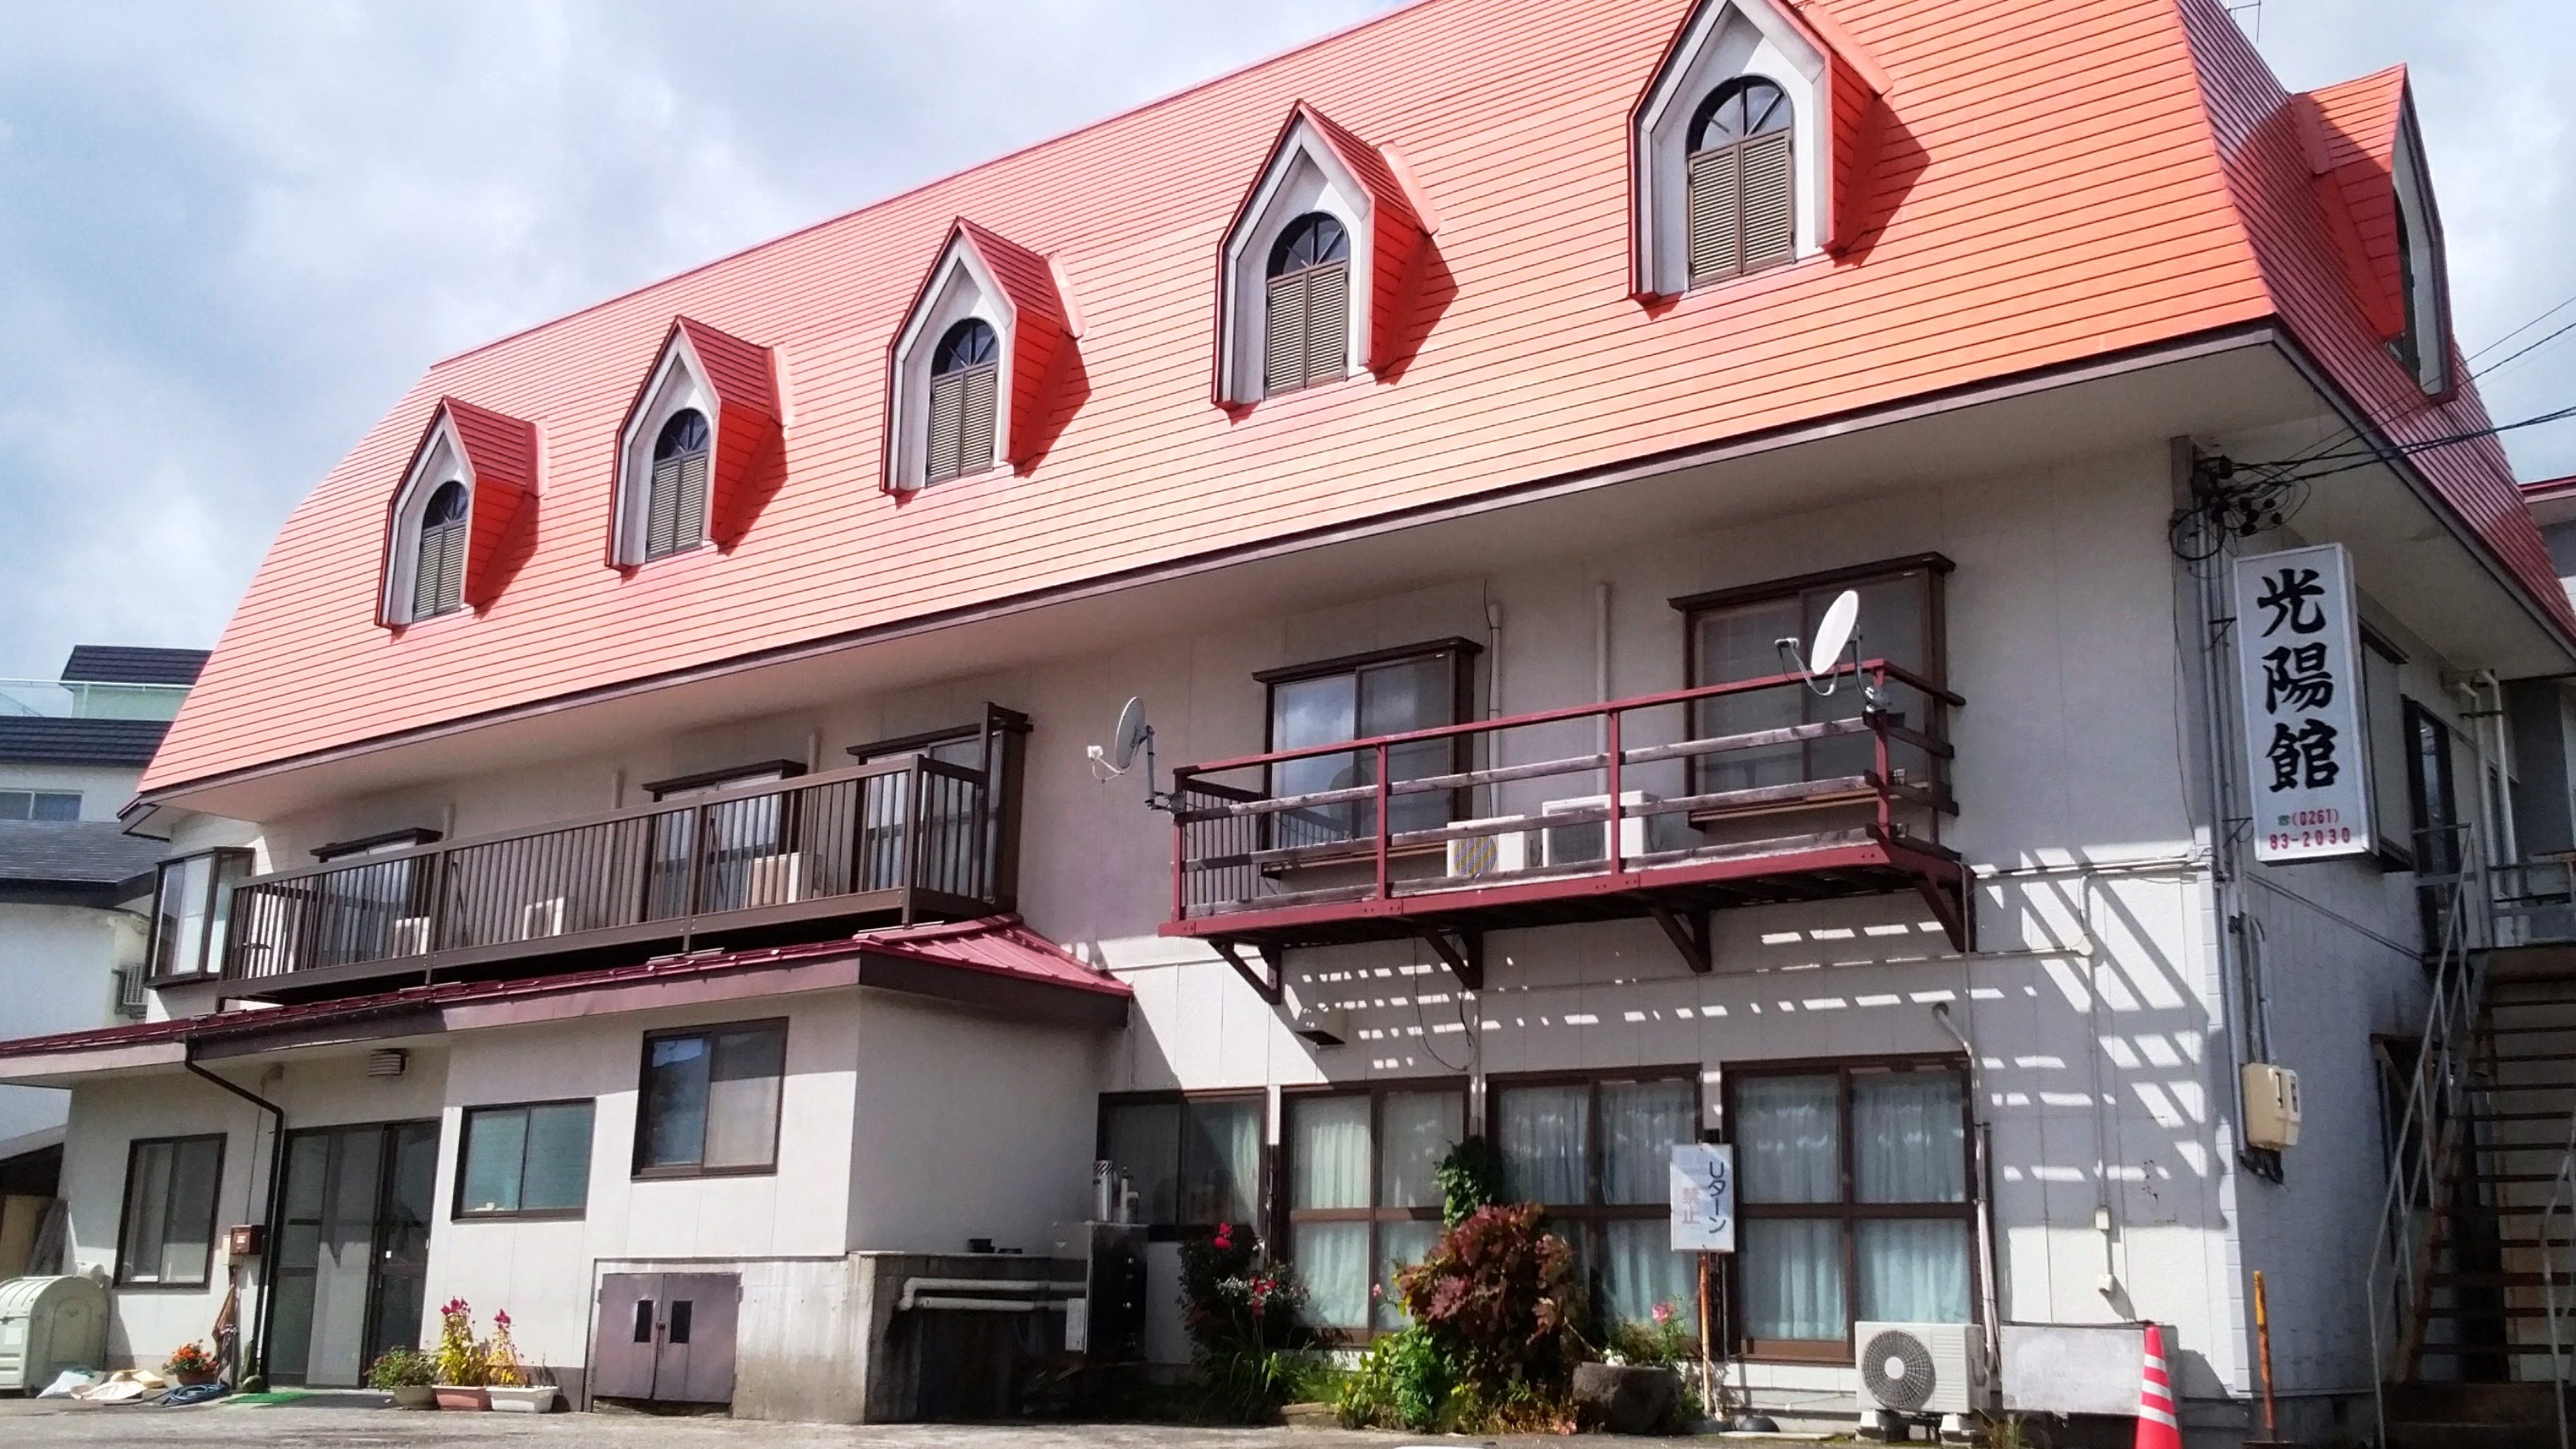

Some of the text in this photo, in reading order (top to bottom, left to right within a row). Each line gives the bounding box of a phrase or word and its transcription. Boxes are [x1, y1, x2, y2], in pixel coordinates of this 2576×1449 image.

[2256, 568, 2340, 793] 光陽館
[2268, 828, 2351, 851] 83-2030
[2292, 808, 2339, 827] (0261)
[1708, 1161, 1726, 1234] Uターン
